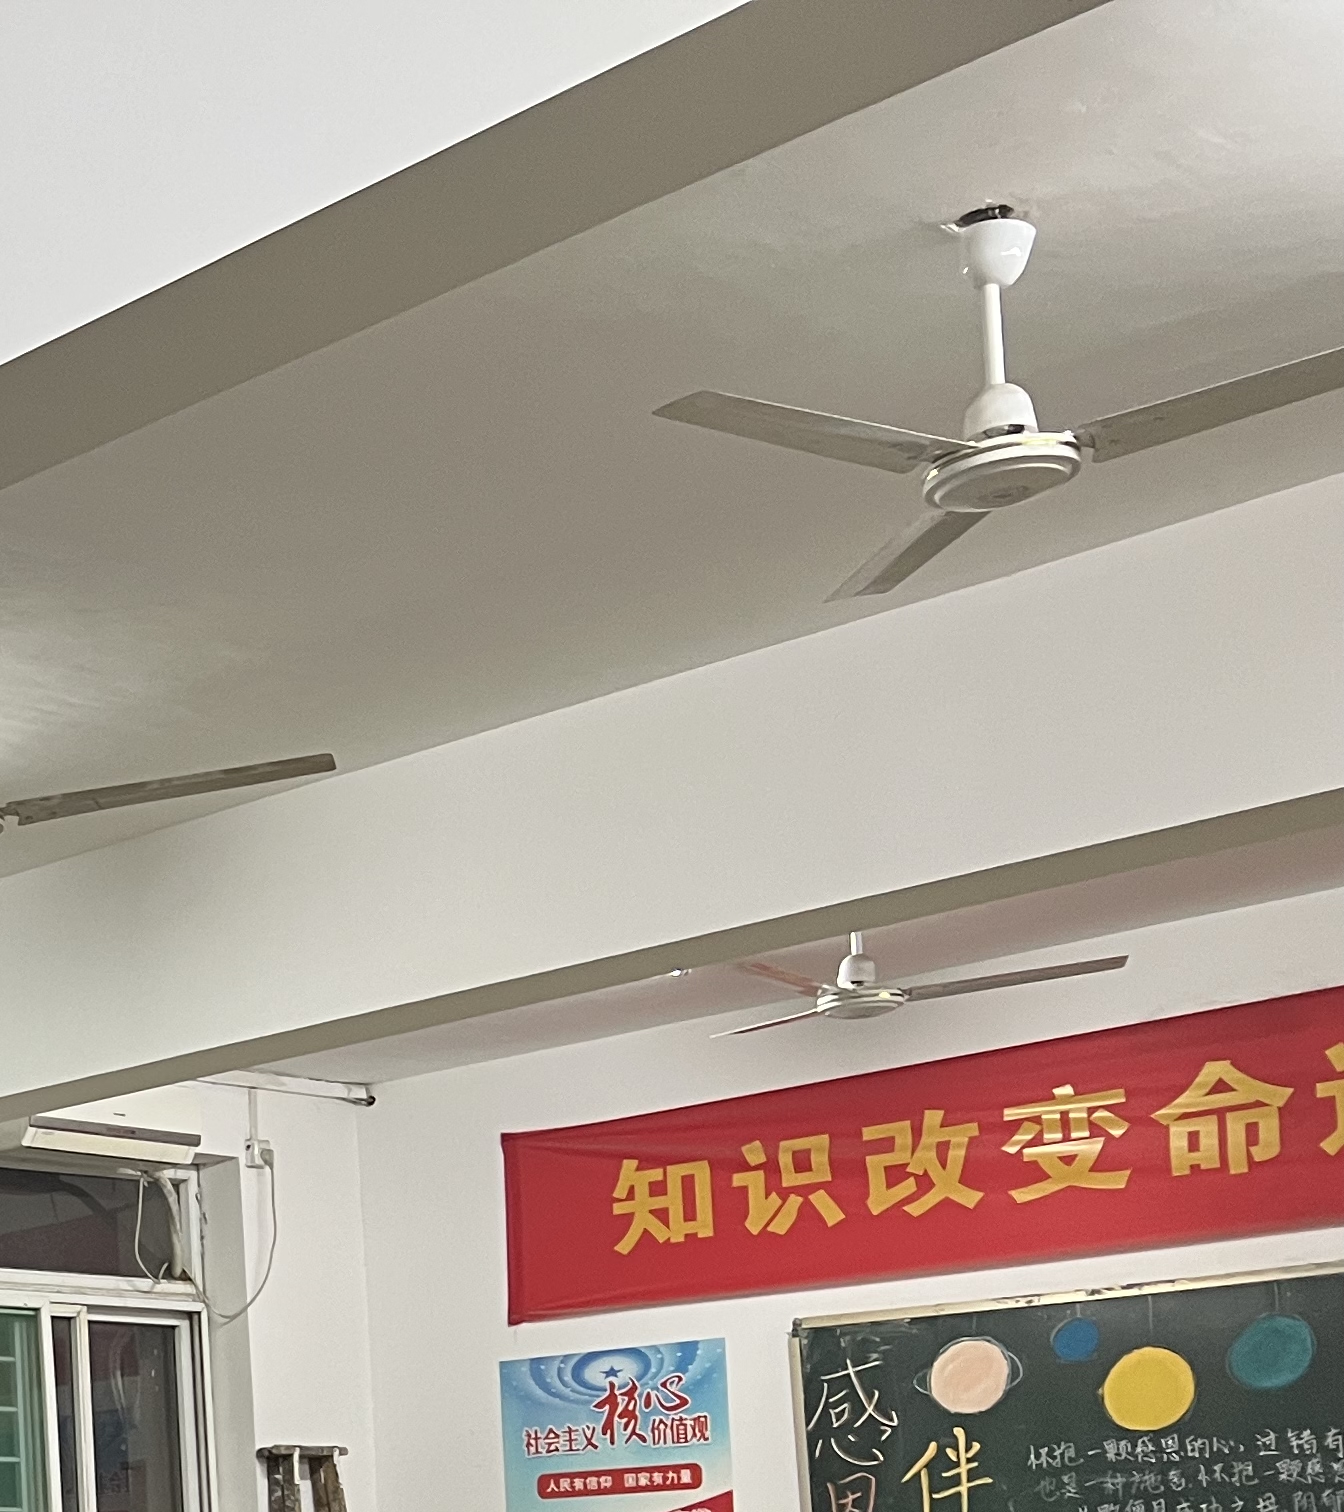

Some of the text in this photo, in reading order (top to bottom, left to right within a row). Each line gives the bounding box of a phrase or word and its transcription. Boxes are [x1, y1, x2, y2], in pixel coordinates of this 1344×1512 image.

[524, 1374, 710, 1456] 社会主义 核心 价值观
[546, 1469, 693, 1493] 人民有信仰 国家有力量
